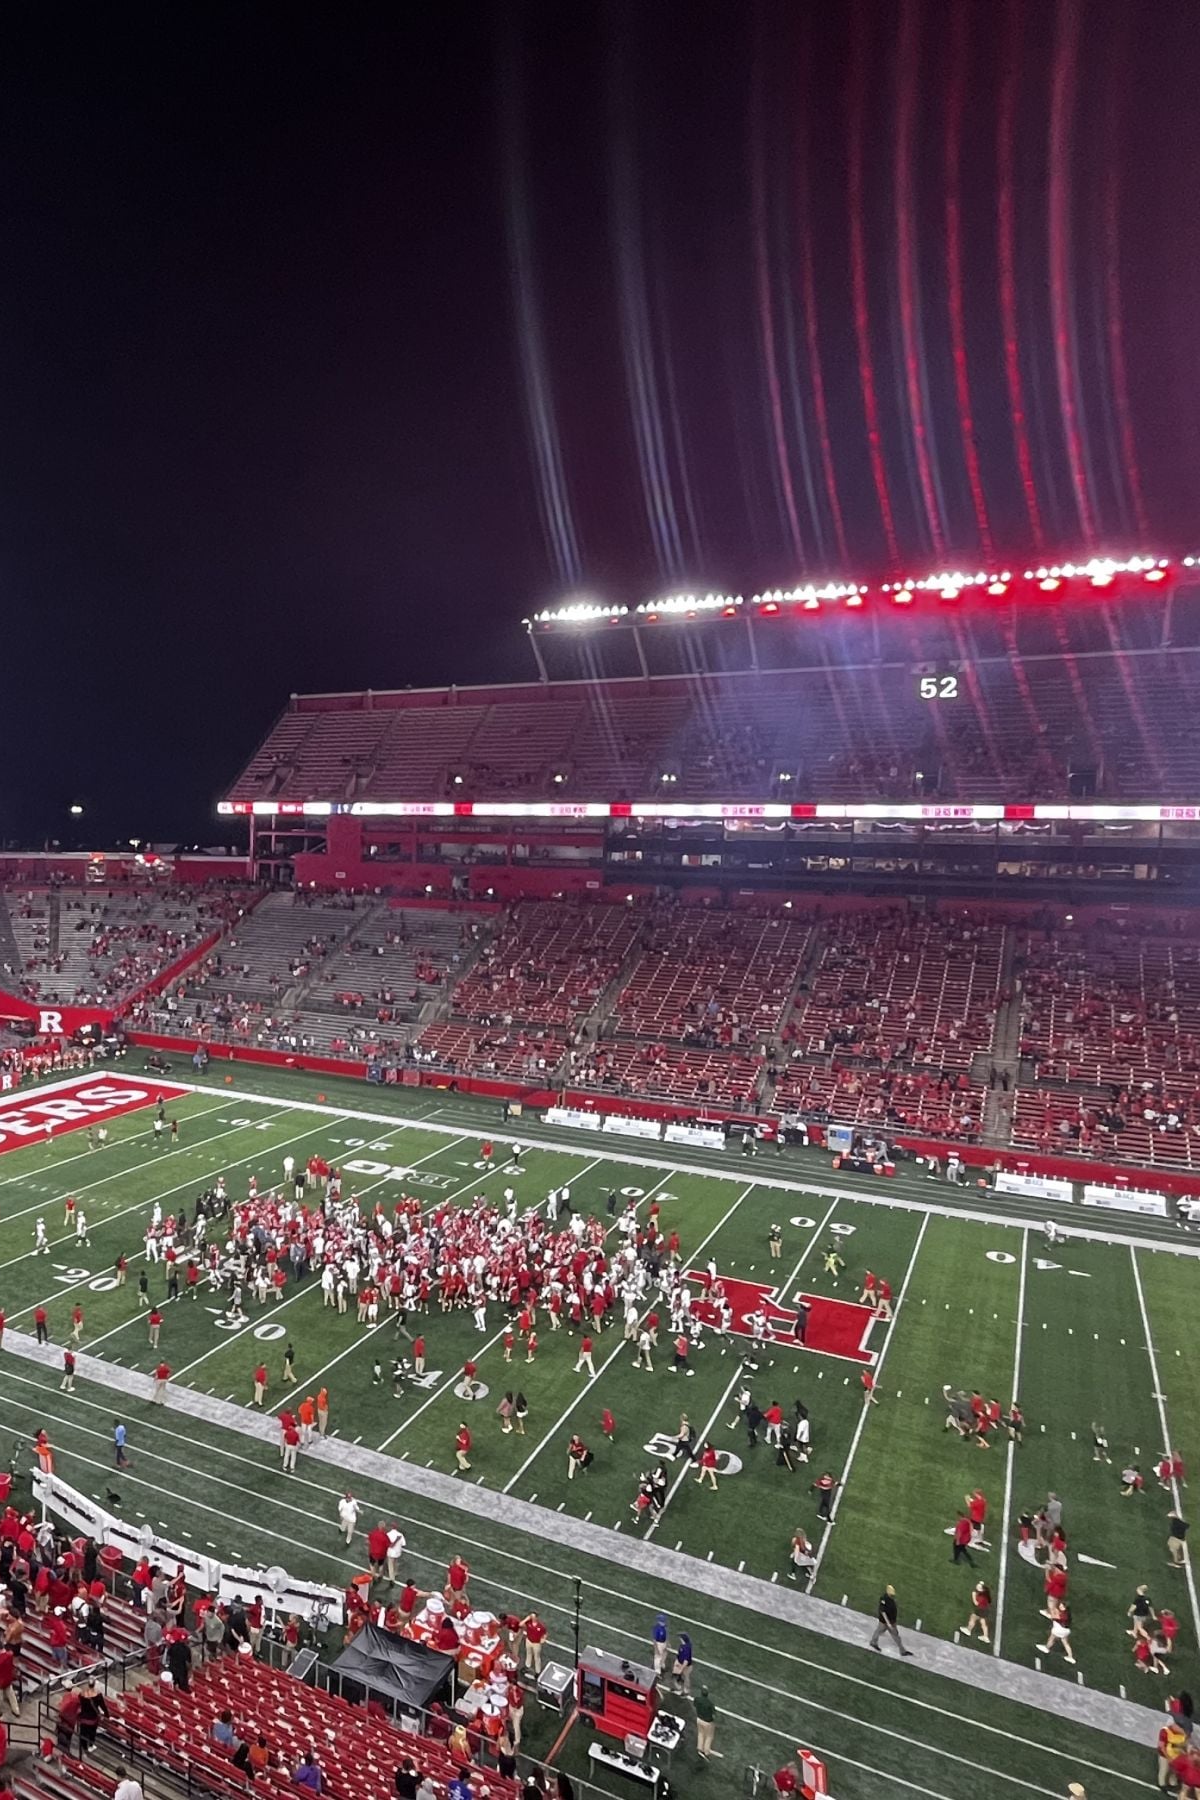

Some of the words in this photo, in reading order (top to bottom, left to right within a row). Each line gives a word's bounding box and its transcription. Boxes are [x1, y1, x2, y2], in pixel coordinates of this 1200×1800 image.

[920, 676, 958, 699] 52
[39, 1011, 64, 1033] R
[2, 1074, 13, 1090] R
[52, 1267, 120, 1292] 20
